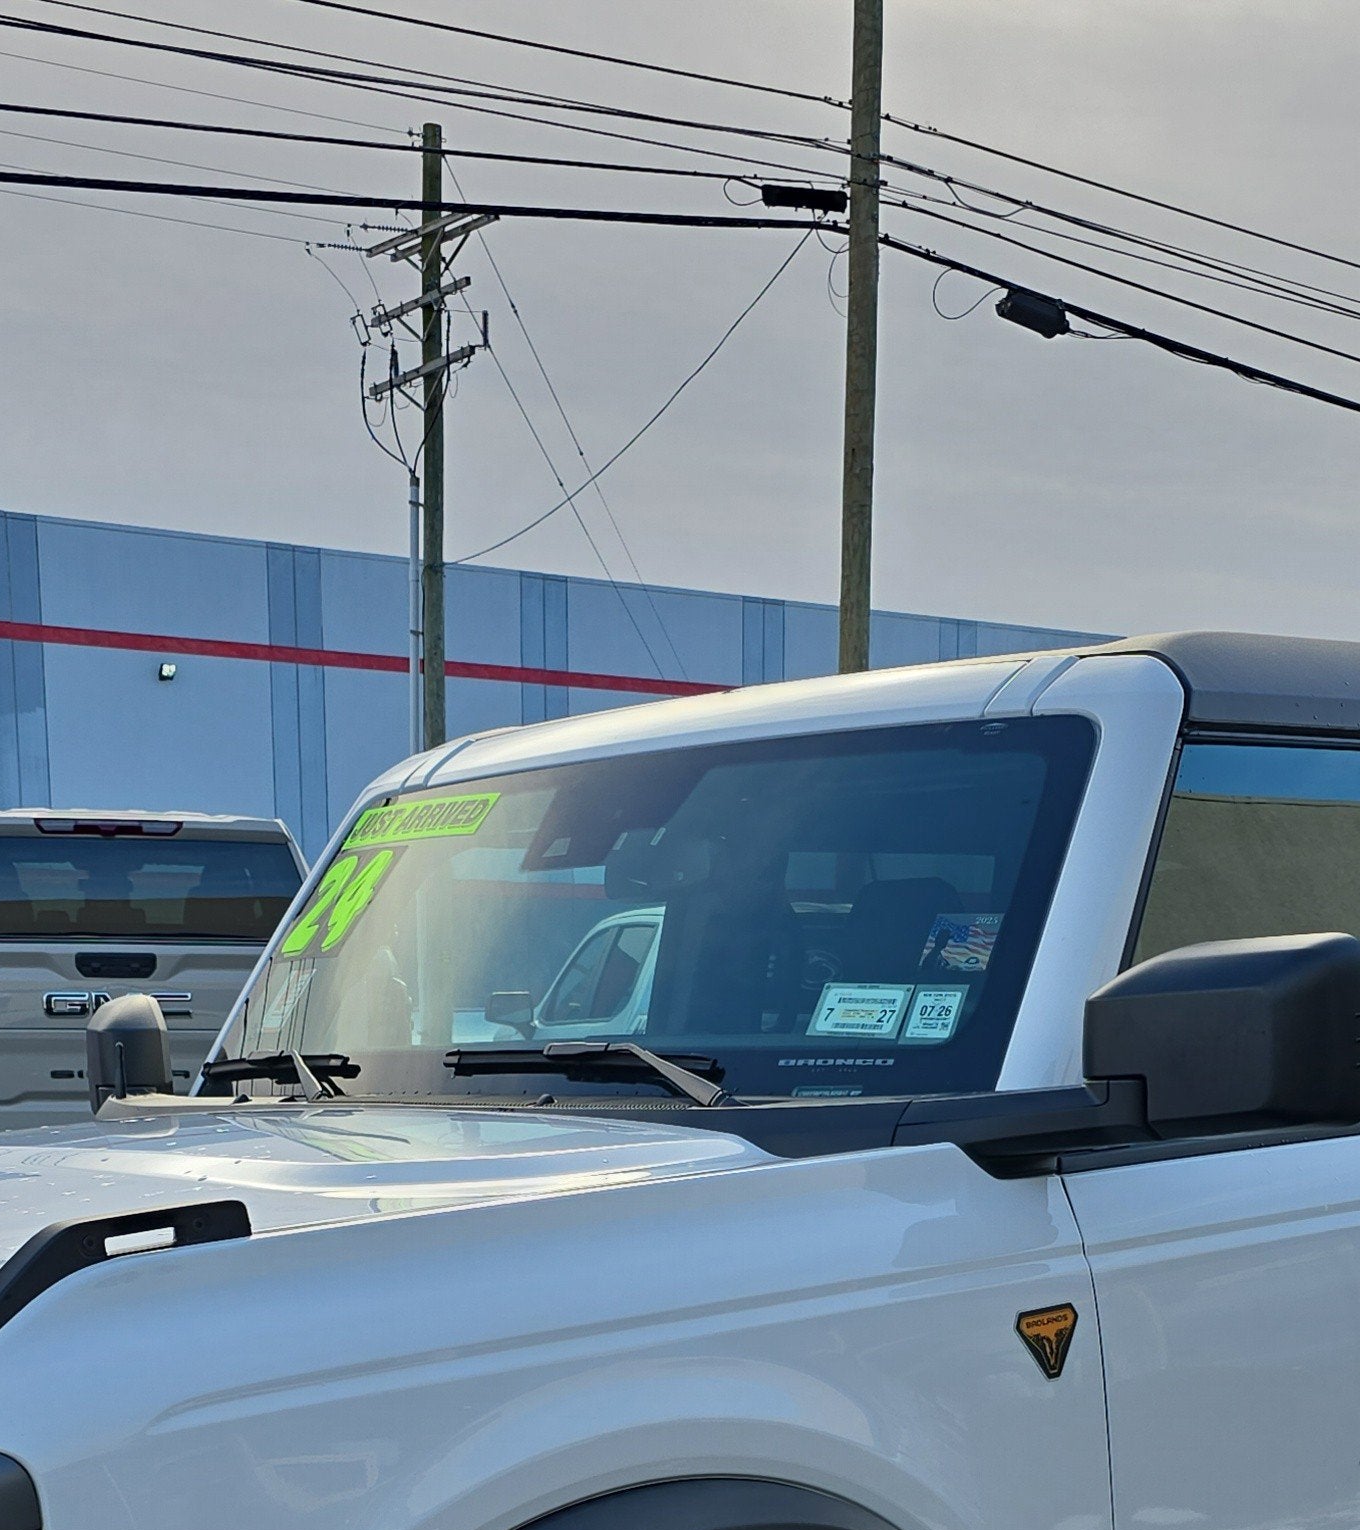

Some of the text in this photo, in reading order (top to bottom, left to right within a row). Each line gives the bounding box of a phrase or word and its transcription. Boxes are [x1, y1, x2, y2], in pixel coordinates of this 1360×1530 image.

[349, 797, 490, 844] JUST ARRIVED
[281, 849, 394, 958] 24
[43, 991, 193, 1016] GC
[919, 1005, 953, 1017] 07 26
[824, 1007, 835, 1022] 7
[876, 1009, 897, 1024] 27
[1025, 1313, 1069, 1329] BADLANDS
